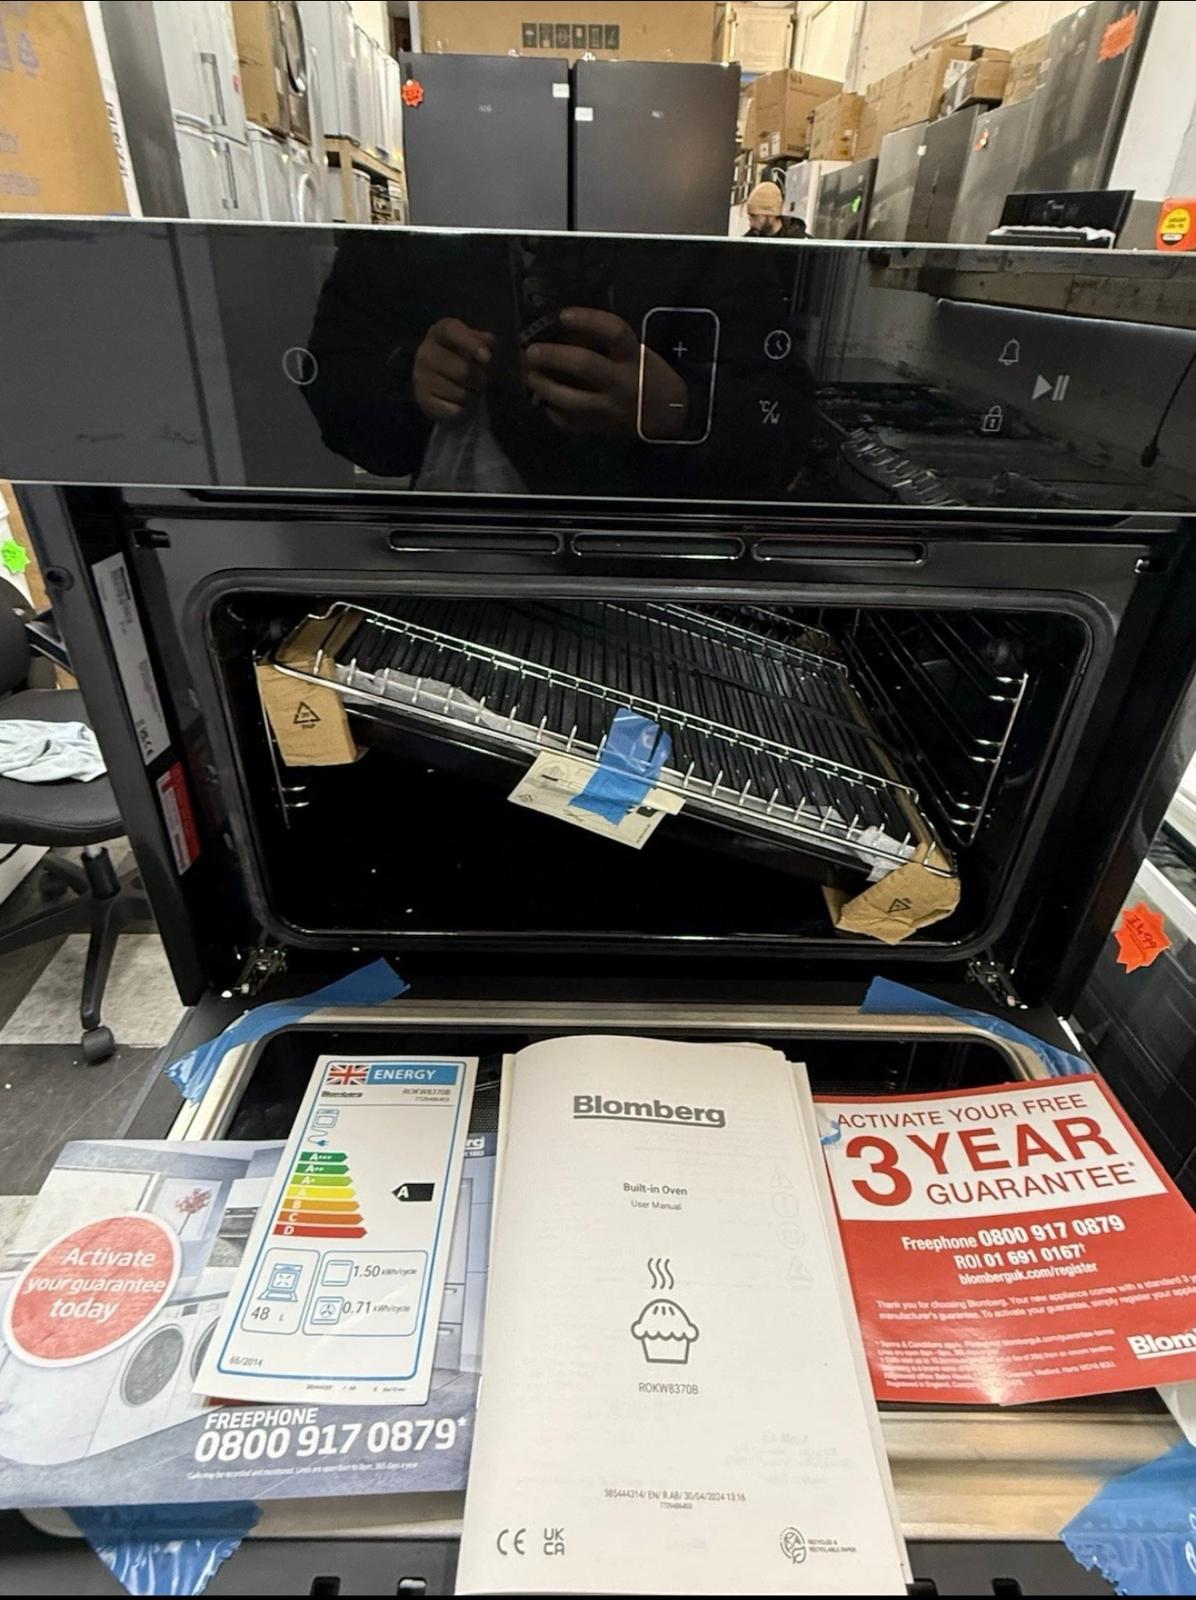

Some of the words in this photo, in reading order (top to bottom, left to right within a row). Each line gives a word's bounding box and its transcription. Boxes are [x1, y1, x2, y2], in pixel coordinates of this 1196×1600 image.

[373, 1069, 436, 1080] ENERGY
[573, 1095, 726, 1128] Blomberg
[837, 1110, 944, 1129] ACTIVATE
[948, 1102, 1018, 1122] YOUR
[1022, 1094, 1088, 1115] FREE
[845, 1135, 912, 1207] 3
[906, 1116, 1119, 1175] YEAR
[296, 1188, 306, 1196] A
[397, 1186, 410, 1198] A
[623, 1182, 660, 1194] Built-in
[662, 1185, 688, 1196] Oven
[292, 1200, 302, 1208] B
[630, 1200, 650, 1209] User
[652, 1200, 682, 1211] Manual
[288, 1213, 298, 1222] C
[283, 1226, 294, 1235] D
[901, 1235, 978, 1252] Freephone
[978, 1227, 1029, 1247] 0800
[1030, 1222, 1068, 1242] 917
[1072, 1214, 1126, 1236] 0879
[61, 1248, 156, 1268] Activate
[953, 1254, 982, 1270] ROI
[982, 1252, 1005, 1268] 01
[1007, 1249, 1038, 1266] 691
[353, 1265, 380, 1278] 1.50
[958, 1262, 1098, 1286] blomberguk.com/register
[22, 1277, 71, 1295] your
[69, 1278, 166, 1295] guarantee
[50, 1298, 119, 1324] today
[250, 1307, 270, 1320] 48
[342, 1301, 372, 1314] 0.71
[638, 1382, 699, 1394] ROKW8370B
[204, 1408, 319, 1430] FREEPHONE
[194, 1426, 291, 1462] 0800
[296, 1423, 362, 1457] 917
[684, 1491, 726, 1502] 30/04/2024
[544, 1528, 565, 1541] UK
[497, 1528, 527, 1556] CE
[543, 1542, 565, 1556] CA
